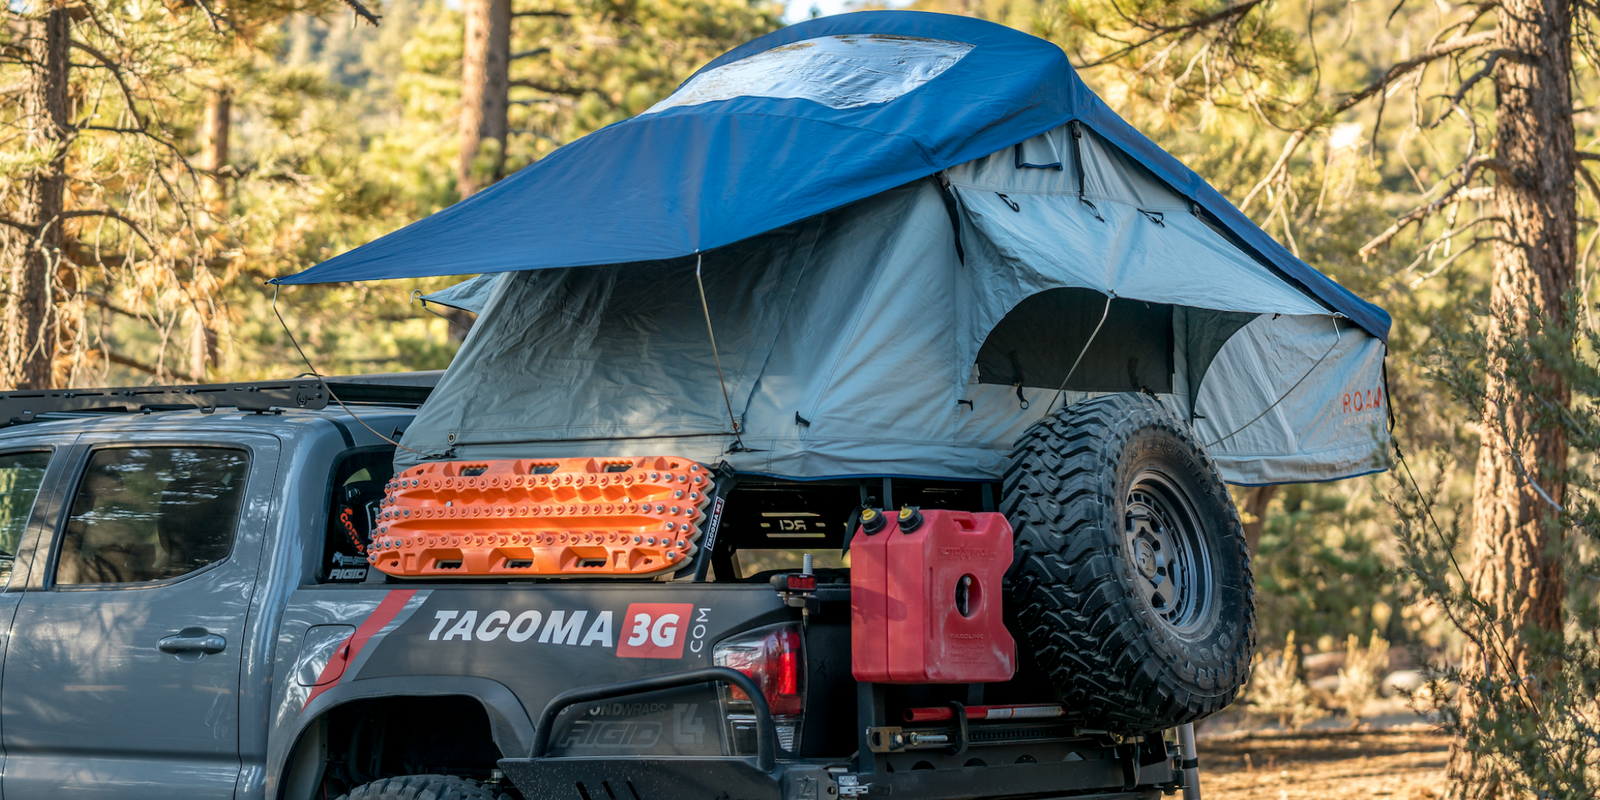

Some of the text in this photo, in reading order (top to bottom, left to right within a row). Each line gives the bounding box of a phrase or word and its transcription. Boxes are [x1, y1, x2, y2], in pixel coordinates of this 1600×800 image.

[1342, 386, 1384, 413] ROAM
[706, 514, 719, 547] TACOMA
[329, 568, 367, 580] RIGID
[428, 609, 680, 648] TACOMA 3G
[690, 607, 712, 658] .COM
[556, 720, 663, 748] RIGID
